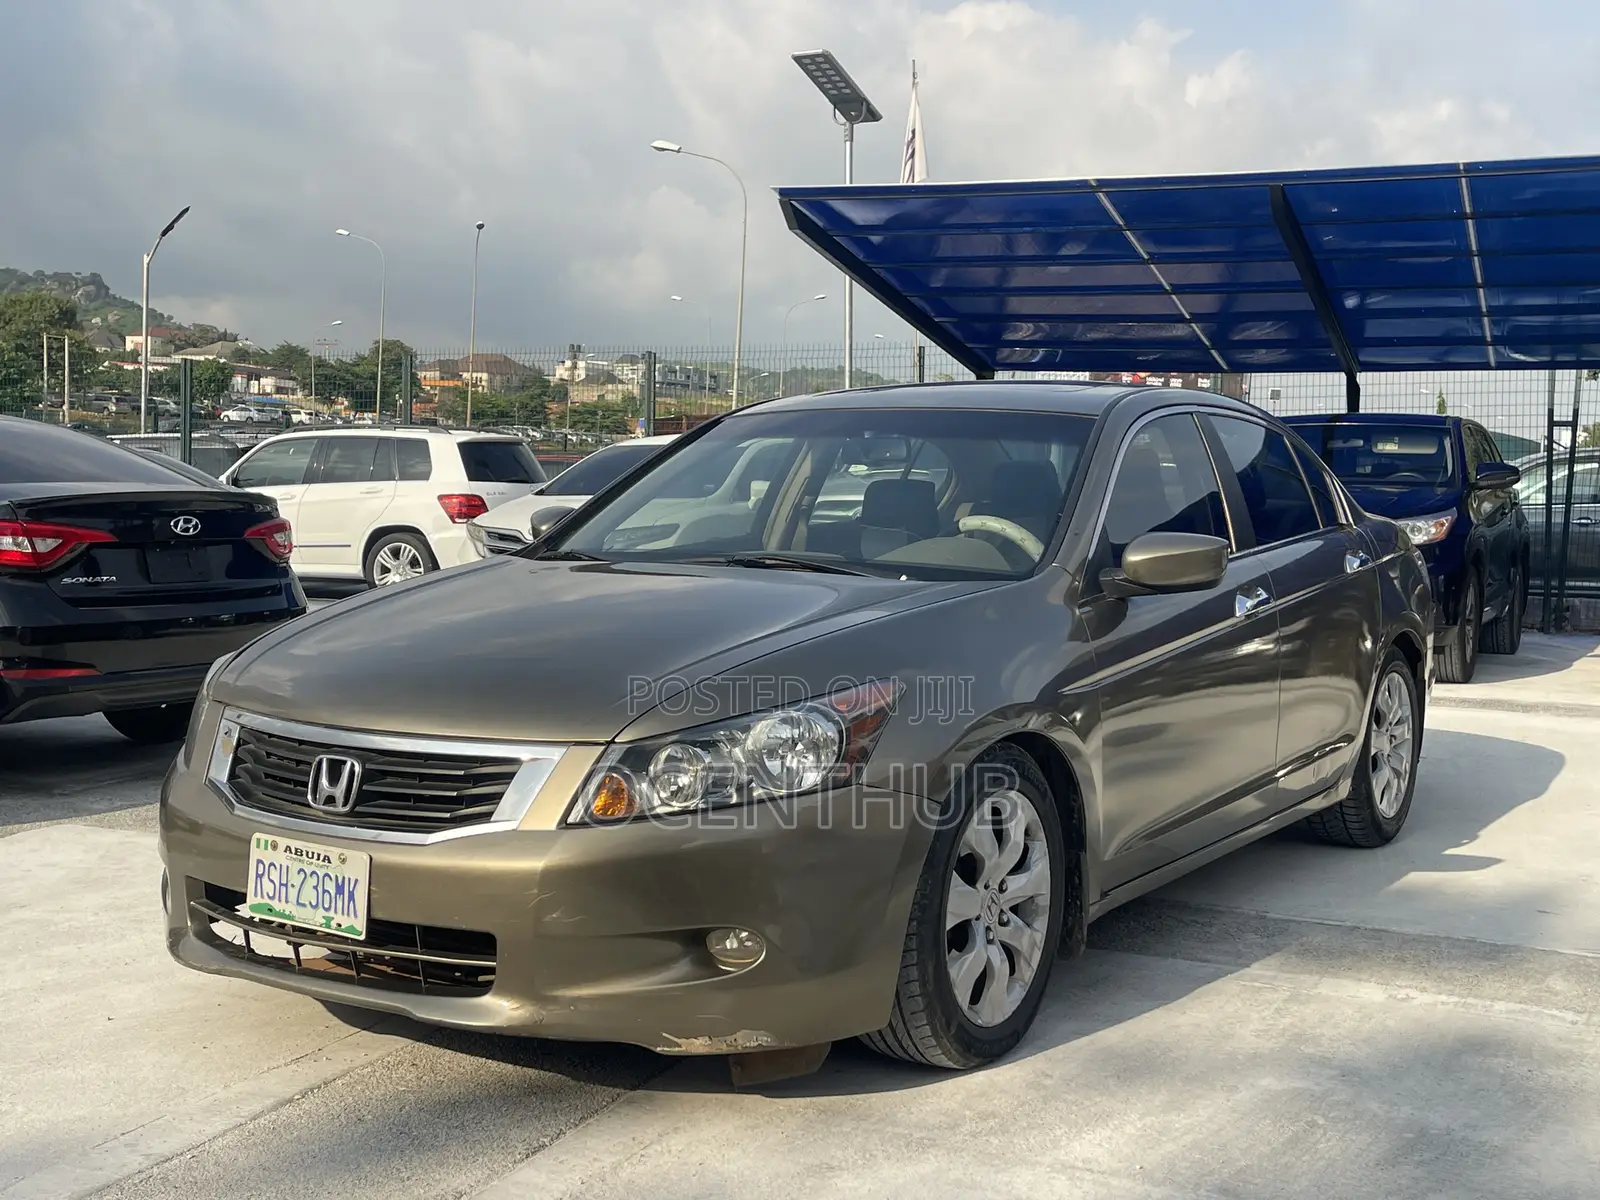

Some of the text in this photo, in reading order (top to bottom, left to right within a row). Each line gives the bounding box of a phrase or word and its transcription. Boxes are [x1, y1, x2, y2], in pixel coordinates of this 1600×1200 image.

[60, 576, 117, 585] SONATA
[283, 844, 332, 865] ABUJA
[253, 858, 359, 919] RSH-236MK
